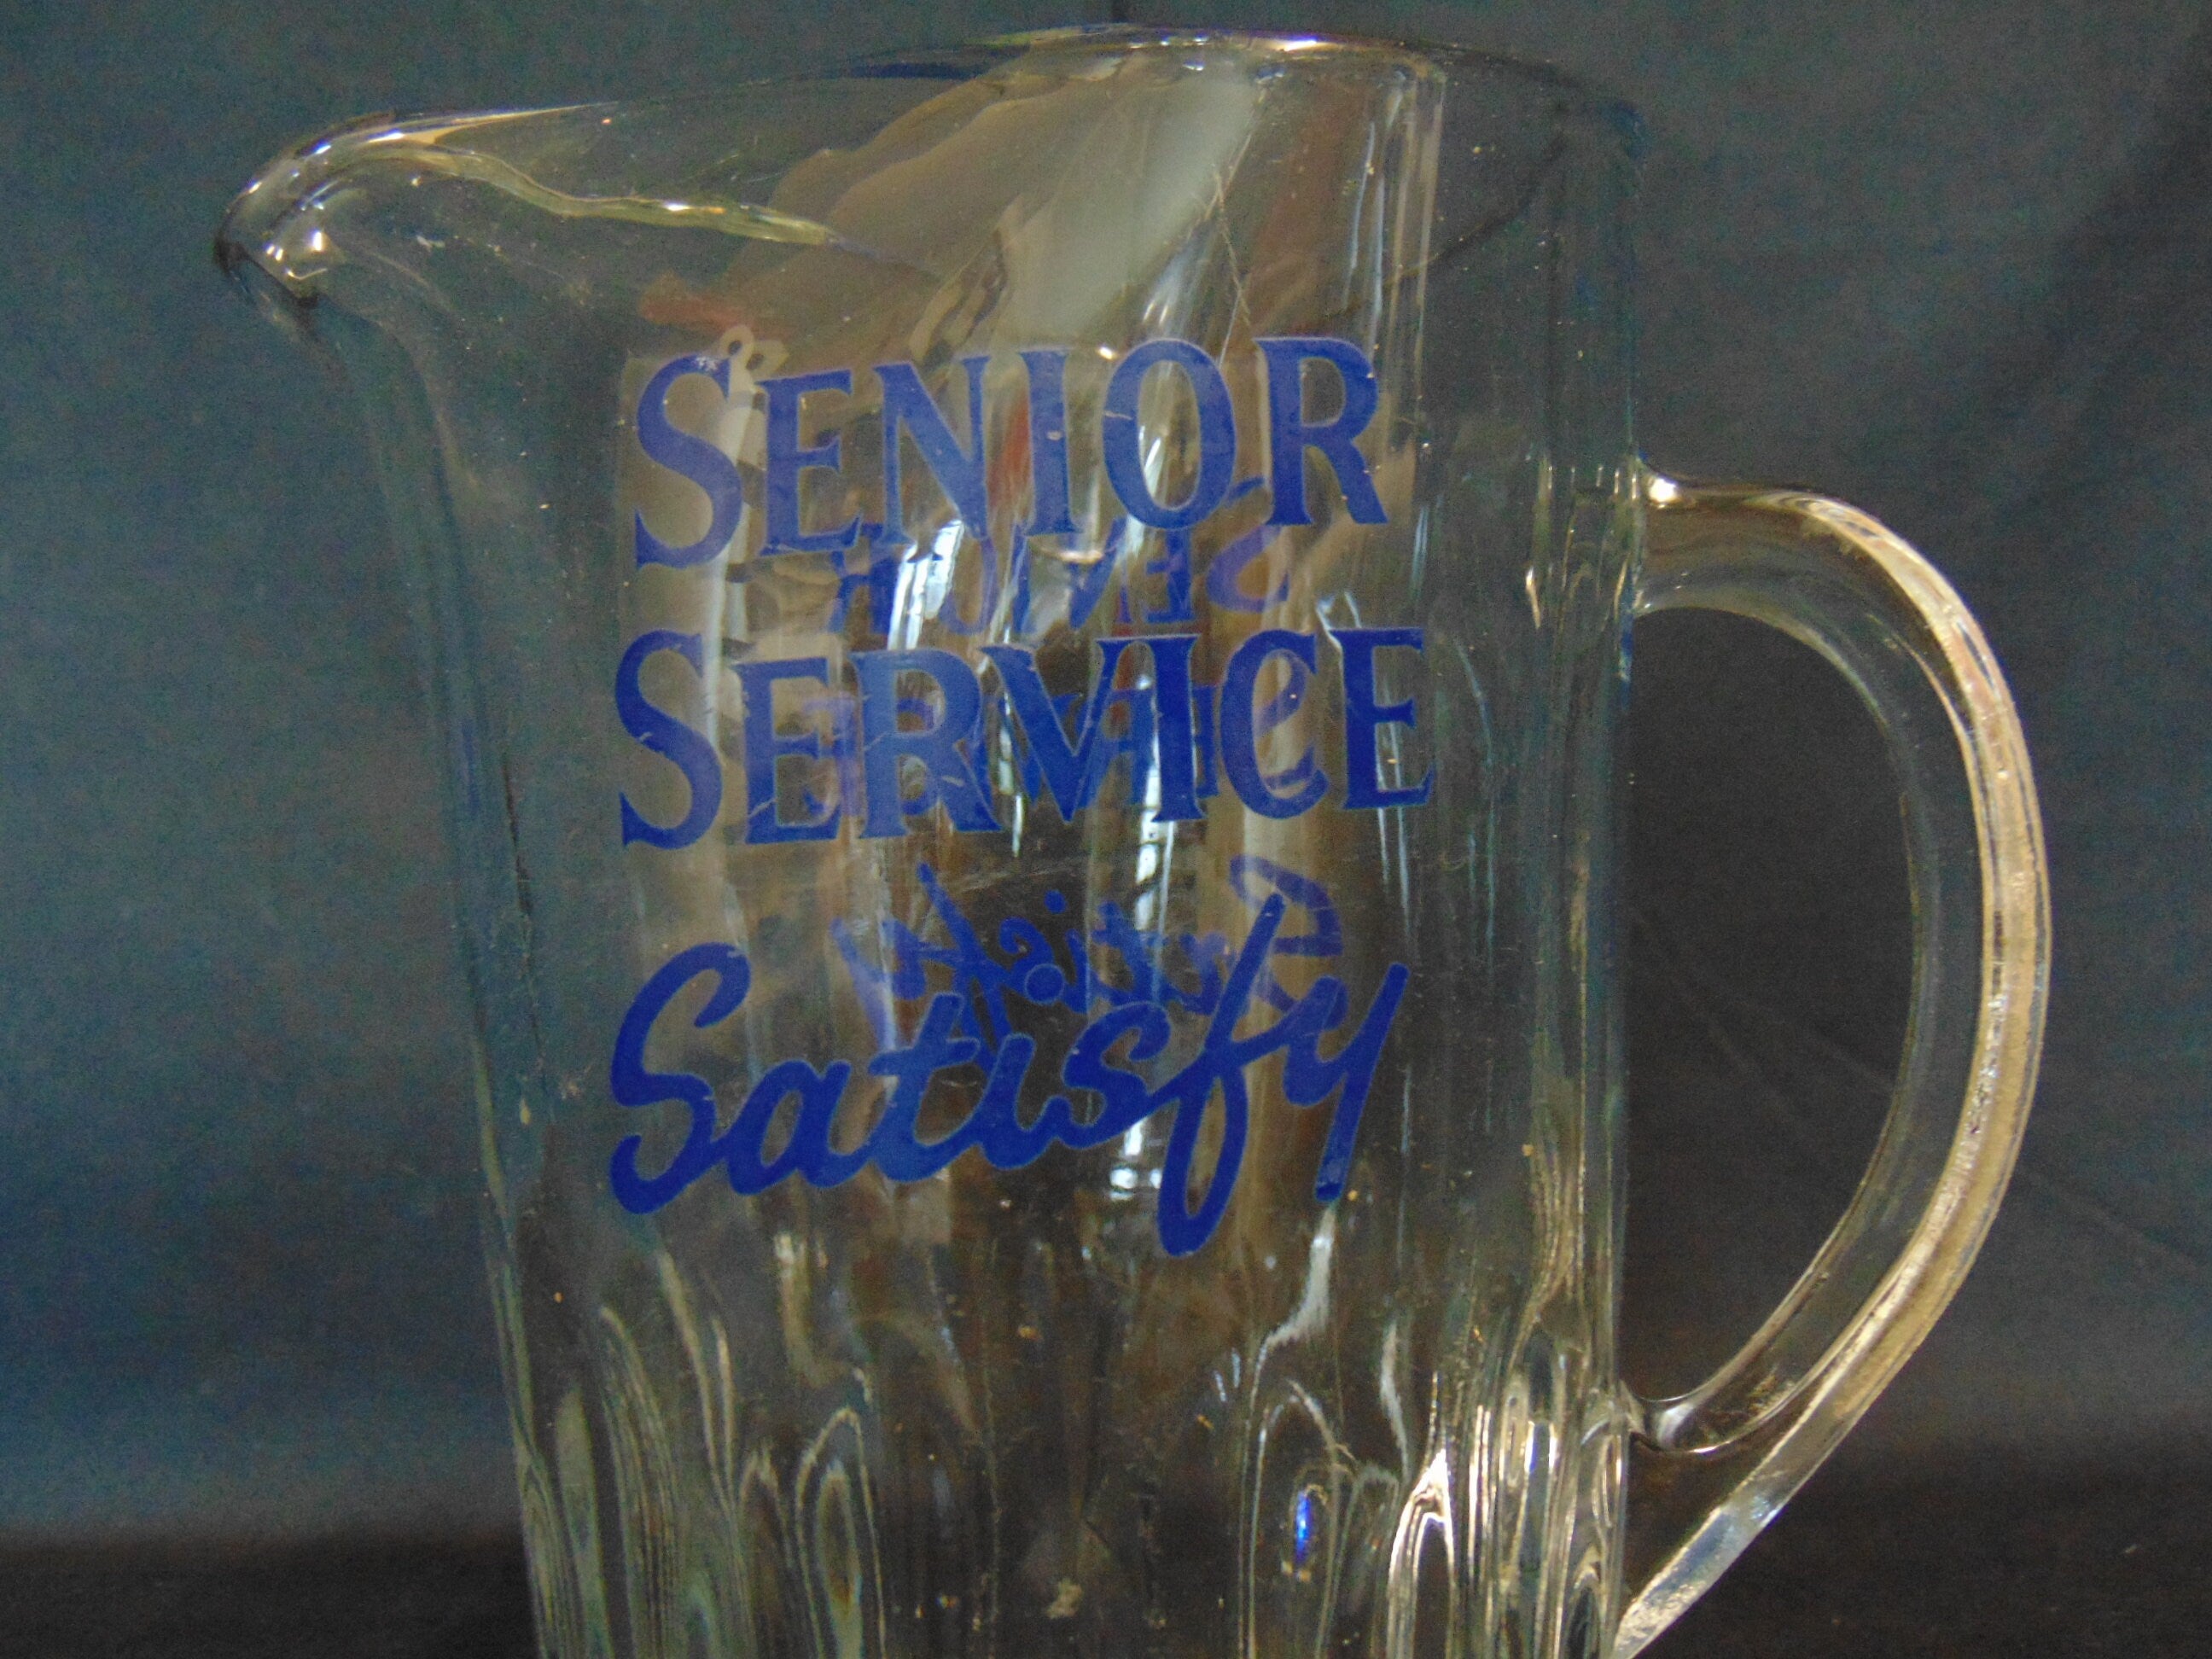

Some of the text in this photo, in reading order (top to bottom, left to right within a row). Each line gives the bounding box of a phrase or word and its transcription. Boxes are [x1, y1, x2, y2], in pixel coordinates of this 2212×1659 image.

[635, 337, 1388, 570] SENIOR
[614, 628, 1434, 851] SERVICE
[610, 893, 1410, 1257] Satisfy
